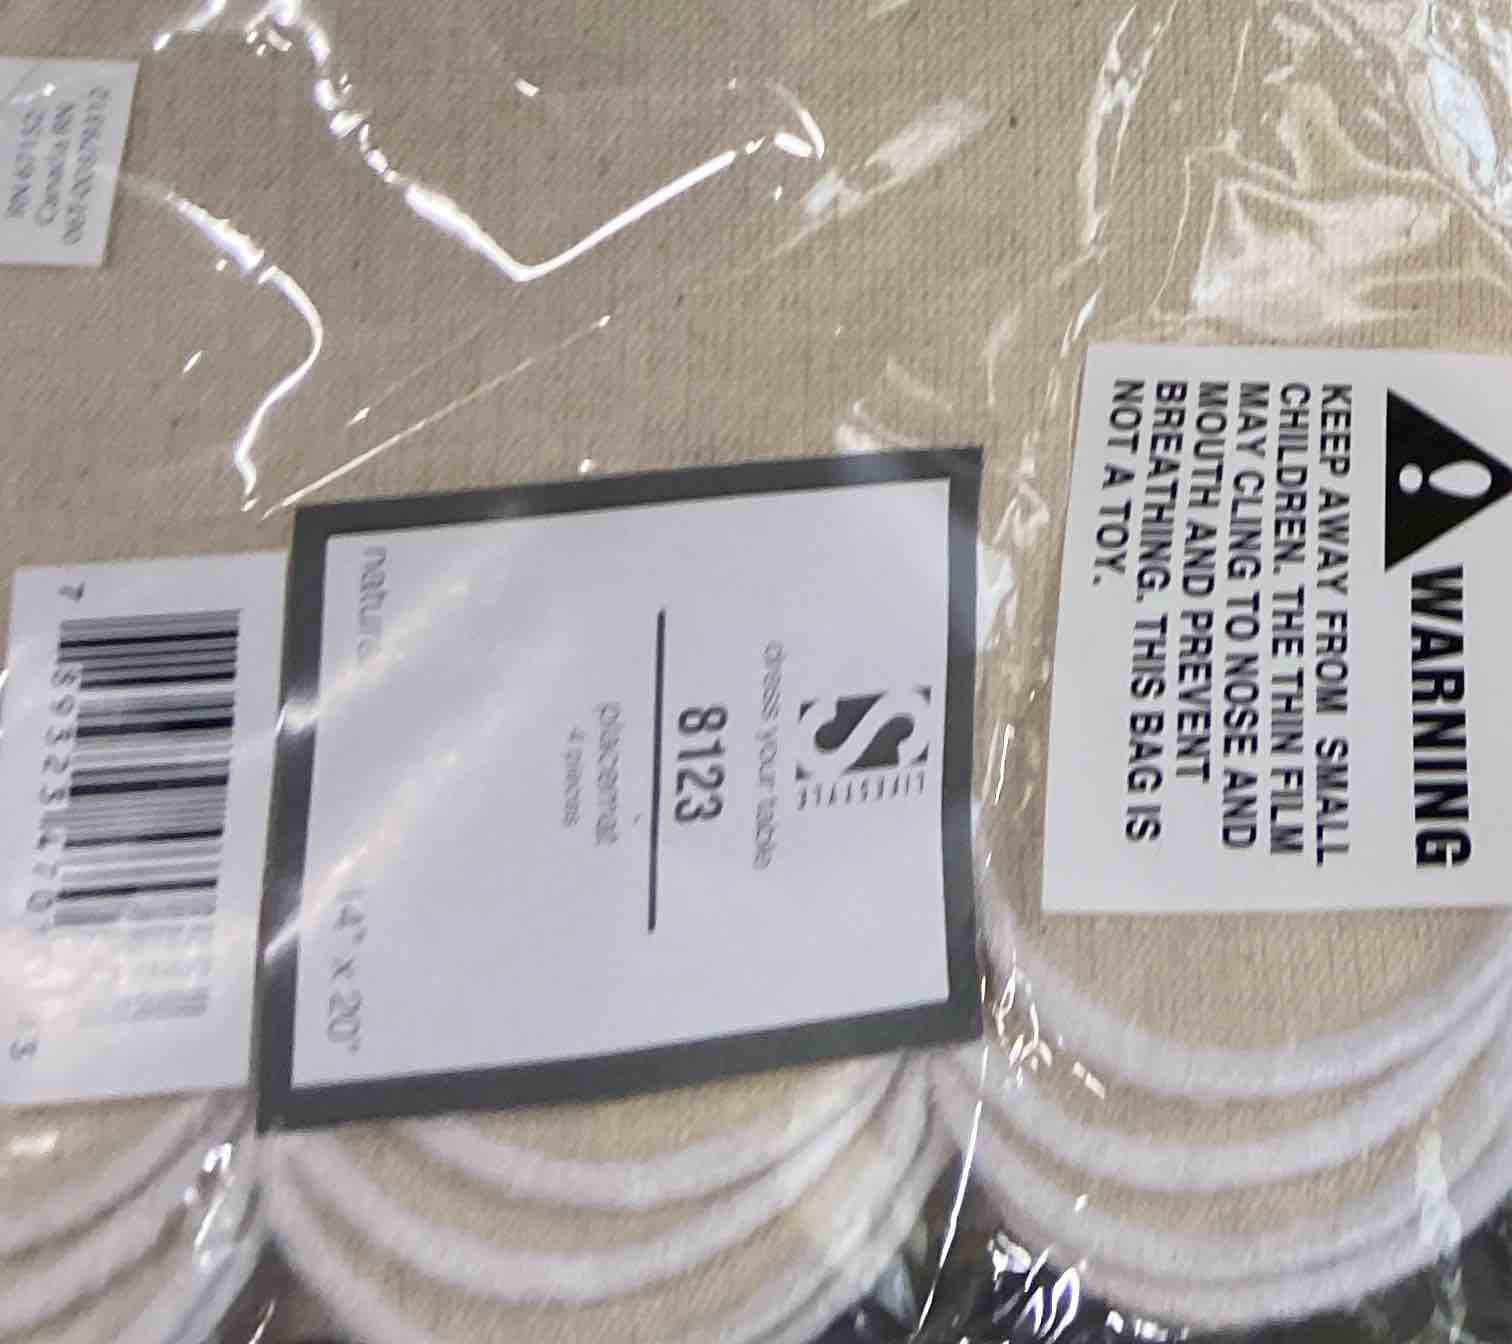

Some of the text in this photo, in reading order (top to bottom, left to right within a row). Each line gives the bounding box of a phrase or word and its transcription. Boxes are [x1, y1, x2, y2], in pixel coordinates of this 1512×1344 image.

[1092, 378, 1146, 586] NOT A TOY.
[1124, 379, 1188, 843] BREATHING. THIS BAG IS
[1175, 380, 1230, 784] MOUTH AND PREVENT
[1221, 382, 1270, 850] MAY CLING TO NOSE AND
[1270, 383, 1311, 855] CHILDREN. THE THIN FILM
[1315, 384, 1353, 867] KEEP AWAY FROM SMALL
[596, 701, 624, 847] placemat
[674, 704, 729, 826] 8123
[752, 640, 786, 871] dress your table
[1410, 564, 1471, 869] WARNING
[329, 956, 356, 979] x
